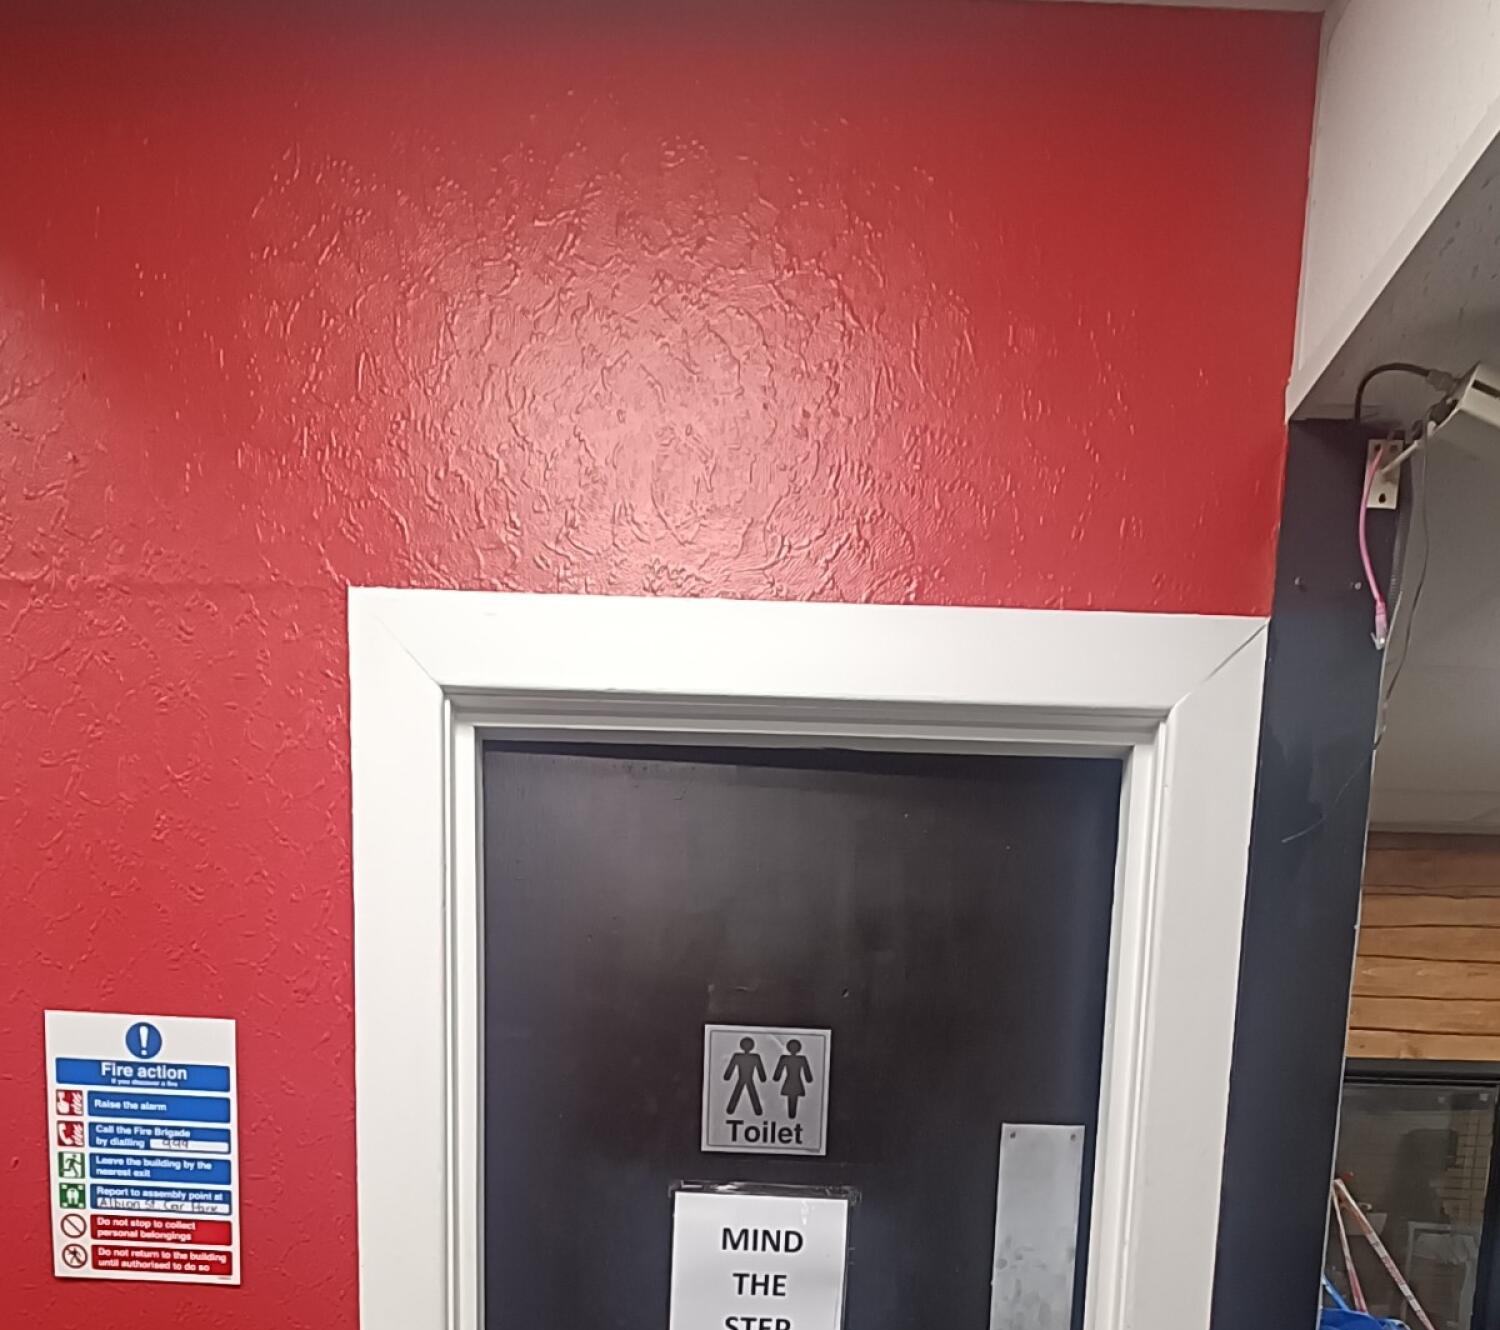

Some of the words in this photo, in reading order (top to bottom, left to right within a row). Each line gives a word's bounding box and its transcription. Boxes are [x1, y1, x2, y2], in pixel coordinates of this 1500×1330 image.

[101, 1062, 134, 1077] Fire
[137, 1066, 187, 1080] action
[94, 1099, 121, 1109] Raise
[123, 1101, 138, 1110] the
[140, 1101, 167, 1111] alarm
[96, 1125, 115, 1134] Call
[116, 1126, 131, 1134] the
[134, 1127, 152, 1135] Fire
[154, 1128, 191, 1138] Brigade
[726, 1120, 803, 1144] Toilet
[96, 1138, 108, 1146] by
[110, 1138, 145, 1148] dialling
[96, 1156, 124, 1166] Leave
[126, 1158, 142, 1166] the
[143, 1158, 181, 1170] building
[183, 1160, 195, 1170] by
[197, 1161, 212, 1170] the
[96, 1168, 131, 1177] nearest
[133, 1169, 151, 1177] exit
[97, 1187, 128, 1197] Report
[130, 1188, 140, 1197] to
[142, 1189, 186, 1200] assembly
[188, 1191, 212, 1201] point
[214, 1193, 223, 1201] at
[97, 1217, 110, 1226] Do
[130, 1219, 151, 1229] stop
[165, 1221, 196, 1230] collect
[97, 1229, 138, 1239] personal
[140, 1231, 192, 1241] belongings
[721, 1228, 804, 1253] MIND
[98, 1247, 110, 1256] Do
[113, 1249, 129, 1257] not
[131, 1250, 159, 1259] return
[173, 1251, 188, 1260] the
[190, 1252, 226, 1264] building
[98, 1258, 119, 1267] until
[121, 1259, 170, 1270] authorised
[173, 1262, 182, 1270] to
[184, 1262, 196, 1271] do
[733, 1273, 787, 1297] THE
